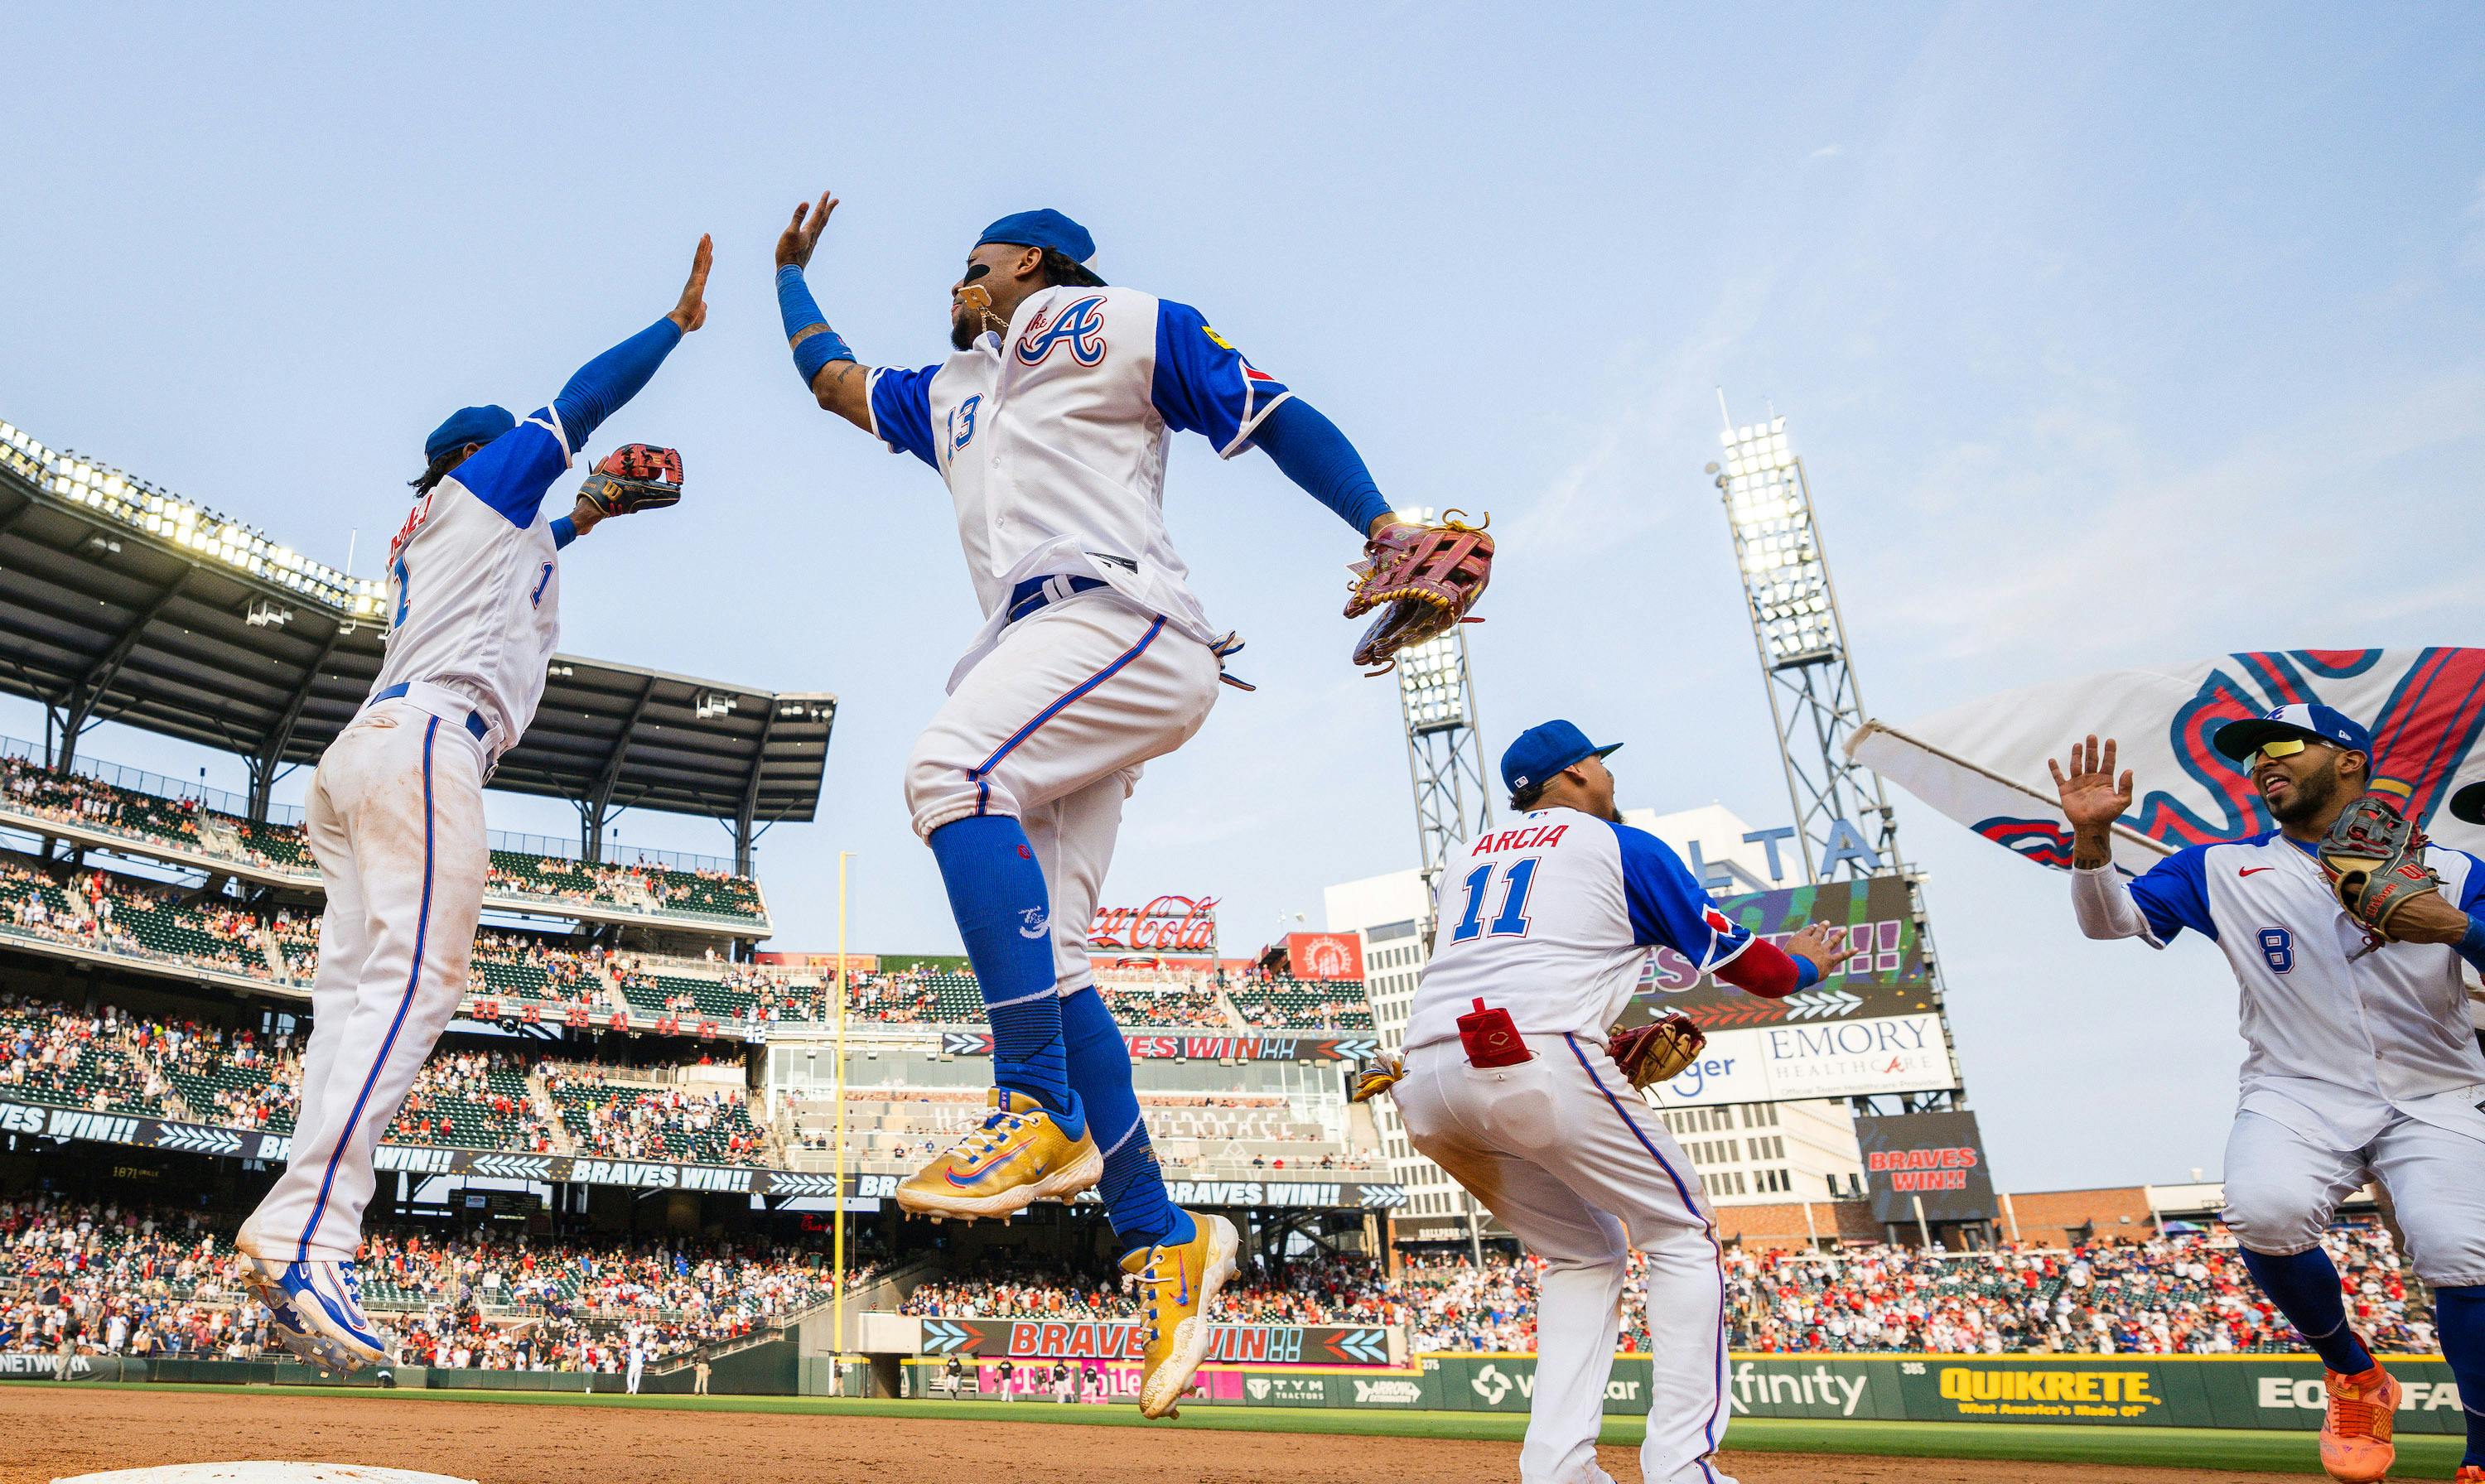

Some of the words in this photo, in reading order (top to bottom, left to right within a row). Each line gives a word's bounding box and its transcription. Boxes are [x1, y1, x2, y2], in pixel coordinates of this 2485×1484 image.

[1015, 295, 1108, 368] A
[1024, 306, 1048, 334] The
[947, 393, 985, 467] 13
[1471, 825, 1570, 857] ARCIA
[1688, 817, 1884, 889] LTA
[1450, 856, 1542, 947] 11
[2365, 883, 2399, 918] Wilson
[1087, 894, 1223, 950] ca-Cola
[2256, 926, 2295, 975] 8
[472, 1000, 499, 1020] 29
[521, 1005, 540, 1024] 31
[565, 1008, 589, 1028] 35
[609, 1013, 629, 1032] 41
[654, 1017, 679, 1036] 44
[696, 1021, 719, 1039] 47
[742, 1025, 766, 1043] 42
[1769, 1018, 1929, 1060] EMORY
[1672, 1058, 1735, 1098] ger
[1776, 1055, 1933, 1079] HEALTHCARE
[47, 1110, 139, 1144] WIN!!
[374, 1145, 455, 1173] WIN!!
[571, 1160, 678, 1188] BRAVES
[681, 1167, 753, 1192] WIN!!
[1869, 1147, 1978, 1172] BRAVES
[1166, 1182, 1263, 1206] BRAVES
[1266, 1183, 1342, 1207] WIN!!
[1892, 1169, 1967, 1192] WIN!!
[1008, 1322, 1144, 1359] BRAVE
[1273, 1380, 1324, 1391] TYM
[1276, 1392, 1324, 1400] TRACTORS
[1939, 1367, 2154, 1402] QUIKRETE
[1957, 1403, 1997, 1414] What
[1999, 1404, 2072, 1416] America's
[2074, 1404, 2118, 1417] Made
